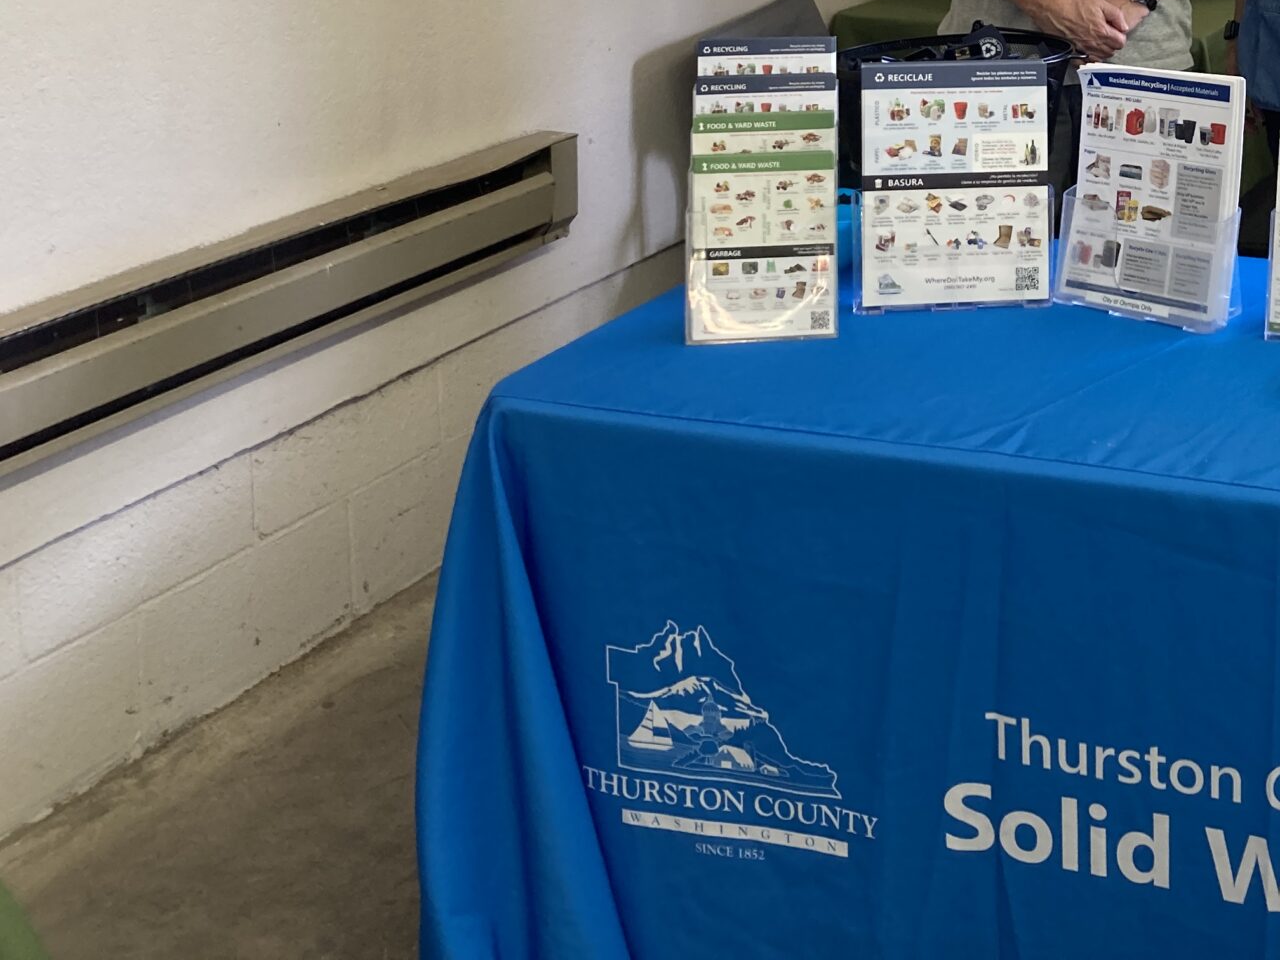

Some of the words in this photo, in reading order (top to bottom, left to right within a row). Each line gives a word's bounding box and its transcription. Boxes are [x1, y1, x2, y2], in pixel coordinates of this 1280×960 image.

[712, 45, 749, 53] RECYCLING
[887, 73, 933, 82] RECICLAJE
[710, 83, 747, 91] RECYCLING
[1108, 76, 1141, 86] Residential
[1140, 80, 1167, 91] Recycling
[1170, 84, 1195, 94] Accepted
[1195, 87, 1219, 97] Materials
[706, 122, 726, 130] FOOD
[757, 161, 780, 169] WASTE
[887, 178, 924, 187] BASURA
[709, 250, 742, 258] GARBAGE
[1102, 295, 1113, 304] City
[1119, 299, 1140, 310] Olympia
[1140, 303, 1153, 313] Only
[984, 710, 1243, 804] Thurston
[582, 765, 745, 814] THURSTON
[754, 794, 879, 840] COUNTY
[628, 811, 838, 852] WASHINGTON
[942, 781, 1172, 890] Solid
[695, 842, 735, 859] SINCE
[738, 845, 766, 861] 1852
